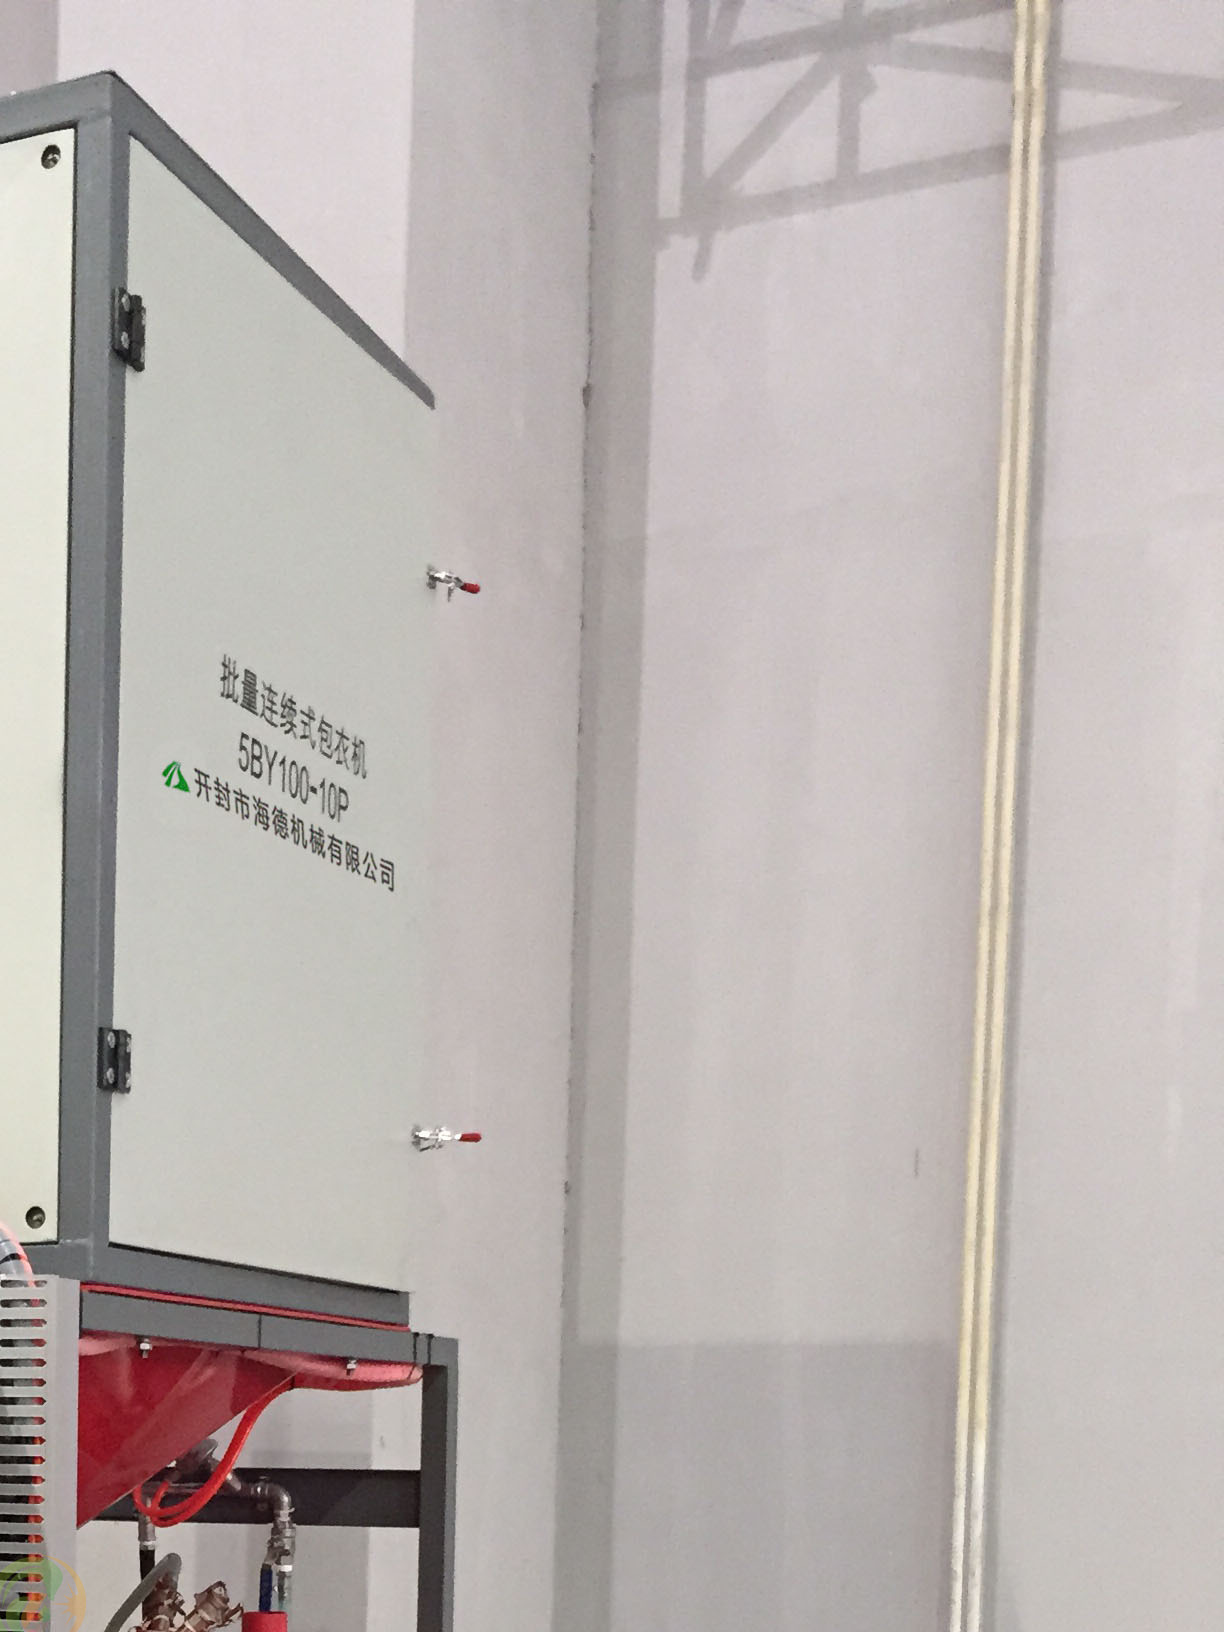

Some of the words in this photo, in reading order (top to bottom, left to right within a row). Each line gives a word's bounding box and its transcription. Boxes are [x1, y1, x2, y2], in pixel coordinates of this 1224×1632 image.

[220, 654, 367, 779] 批量连续式包衣机
[238, 732, 349, 822] 5BY100-10P
[194, 768, 394, 892] 开封市海德机械有限公司
